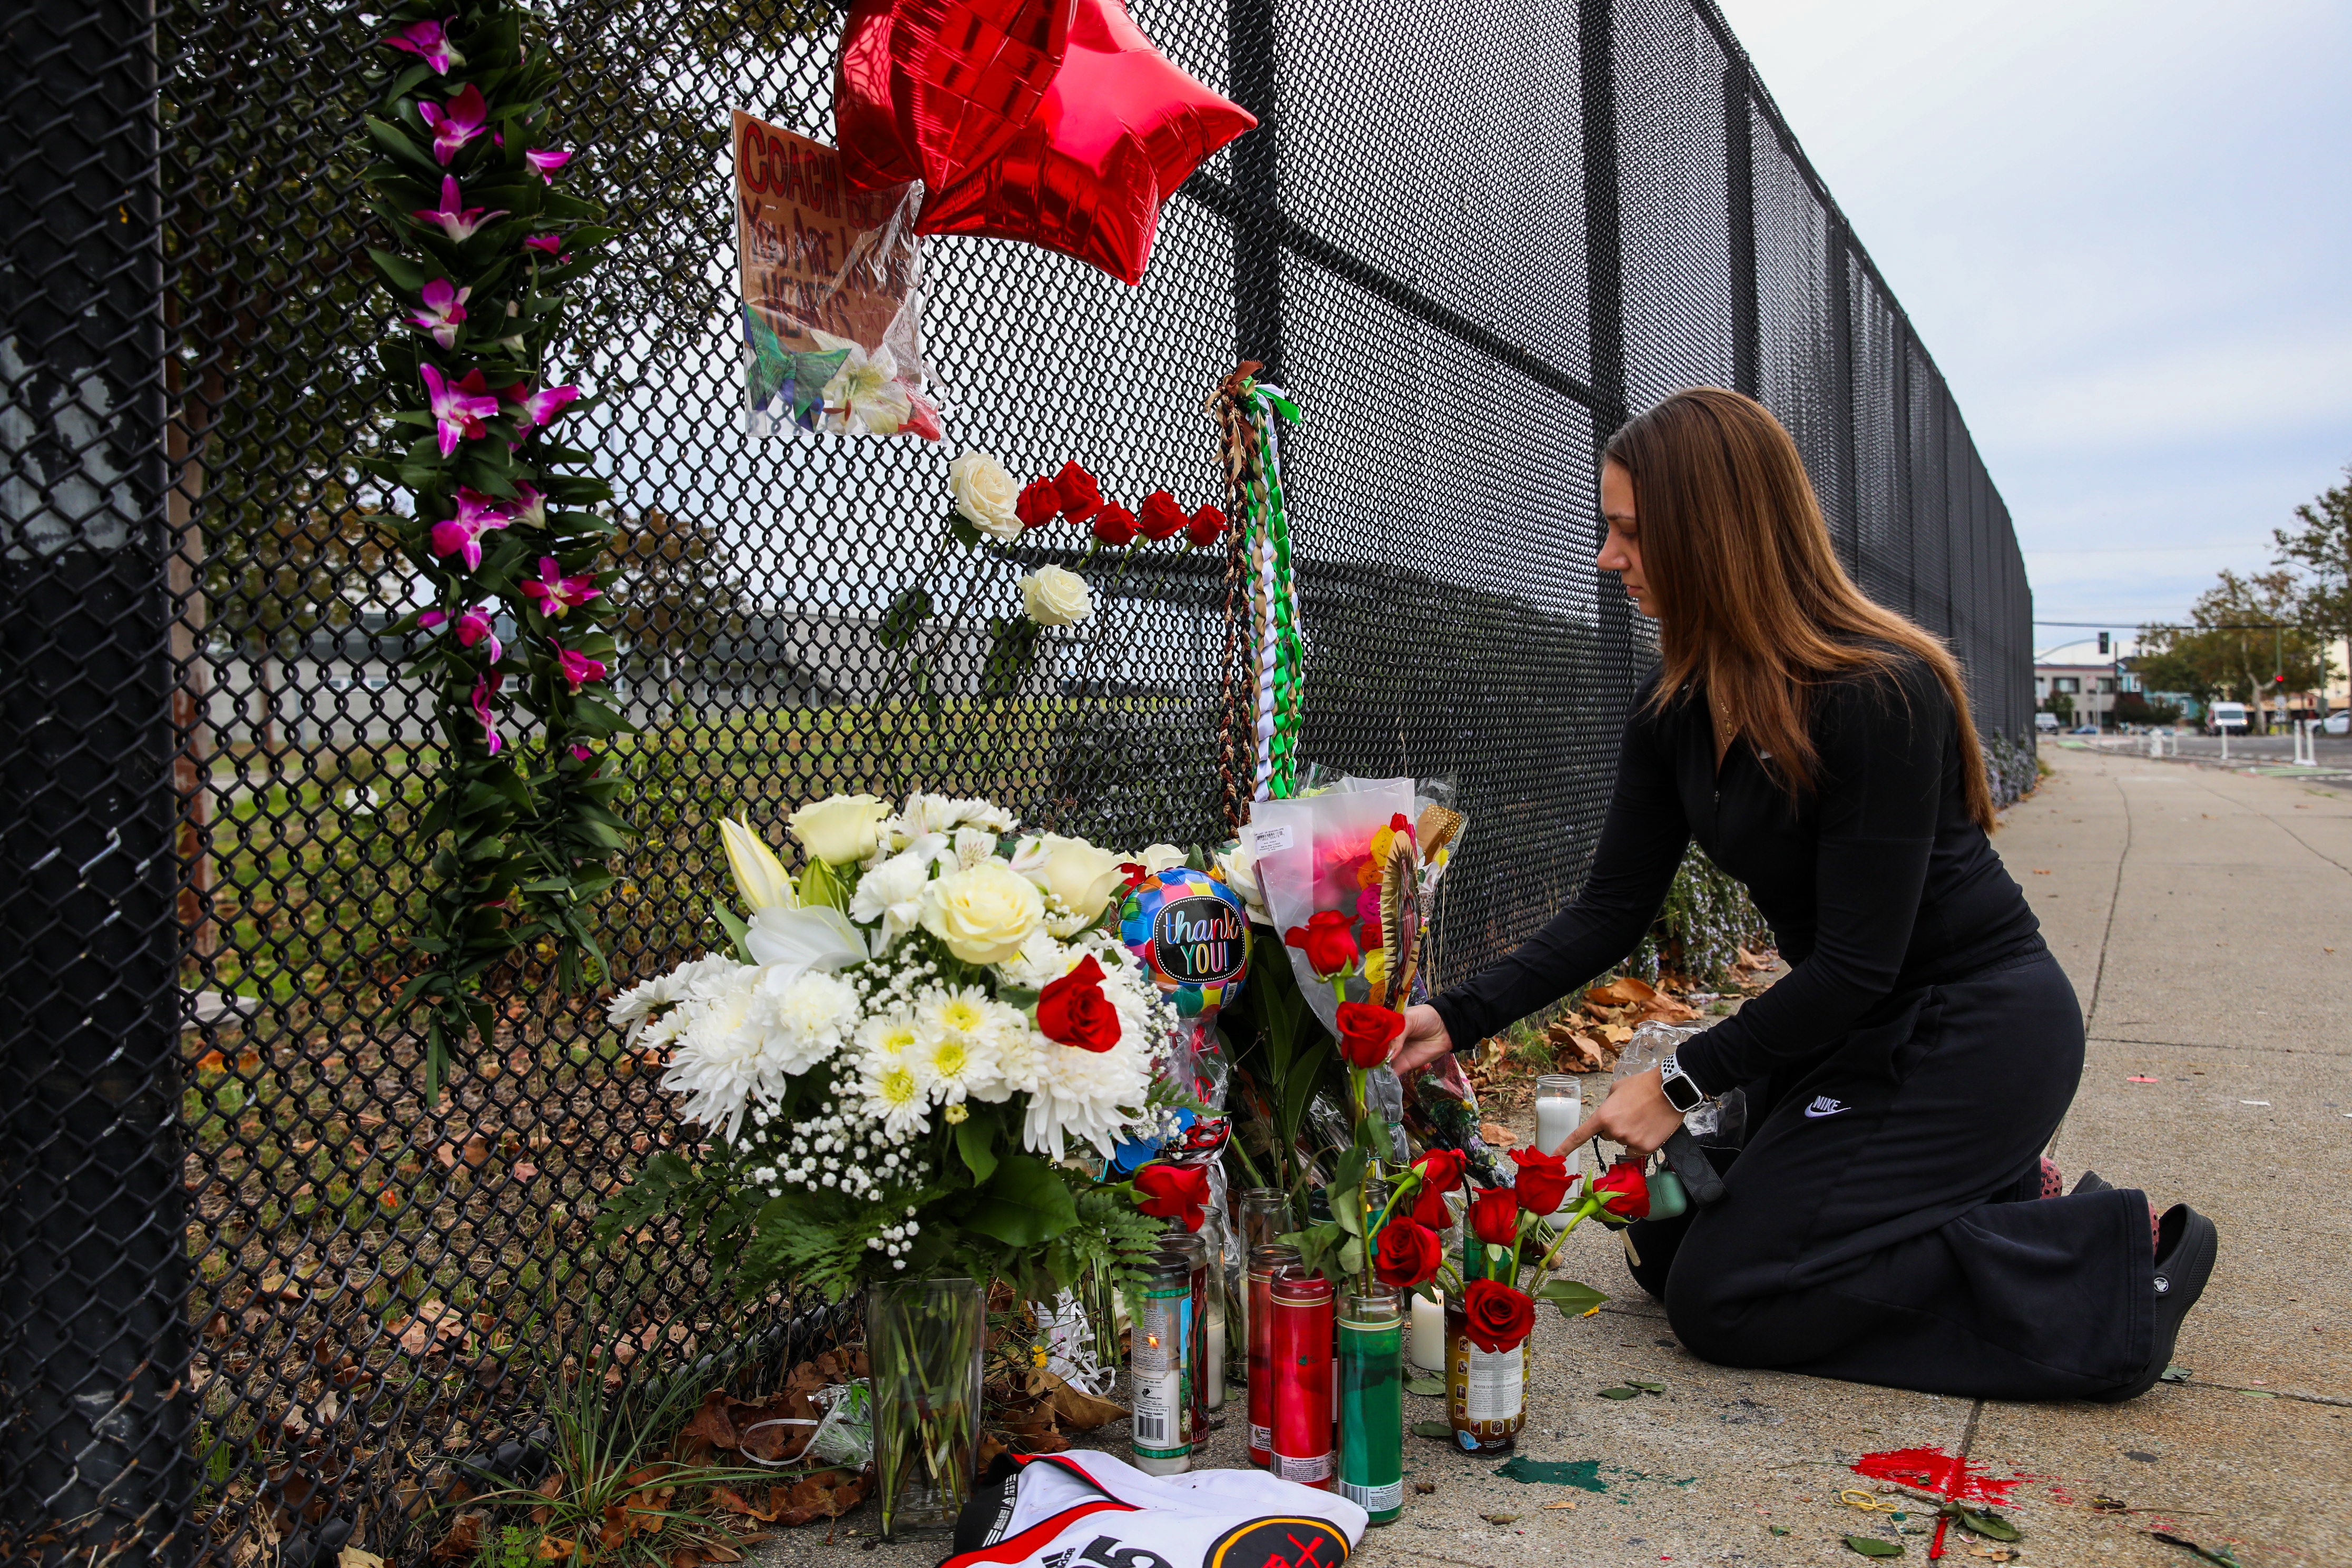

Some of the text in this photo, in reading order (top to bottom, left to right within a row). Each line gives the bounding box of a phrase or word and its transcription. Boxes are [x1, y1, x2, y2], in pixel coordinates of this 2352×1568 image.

[741, 121, 840, 218] COACH
[741, 195, 788, 267] YOU
[793, 208, 839, 279] ARE
[1163, 908, 1239, 944] thank
[1180, 942, 1229, 975] YOU!
[1812, 1096, 1840, 1112] NIKE
